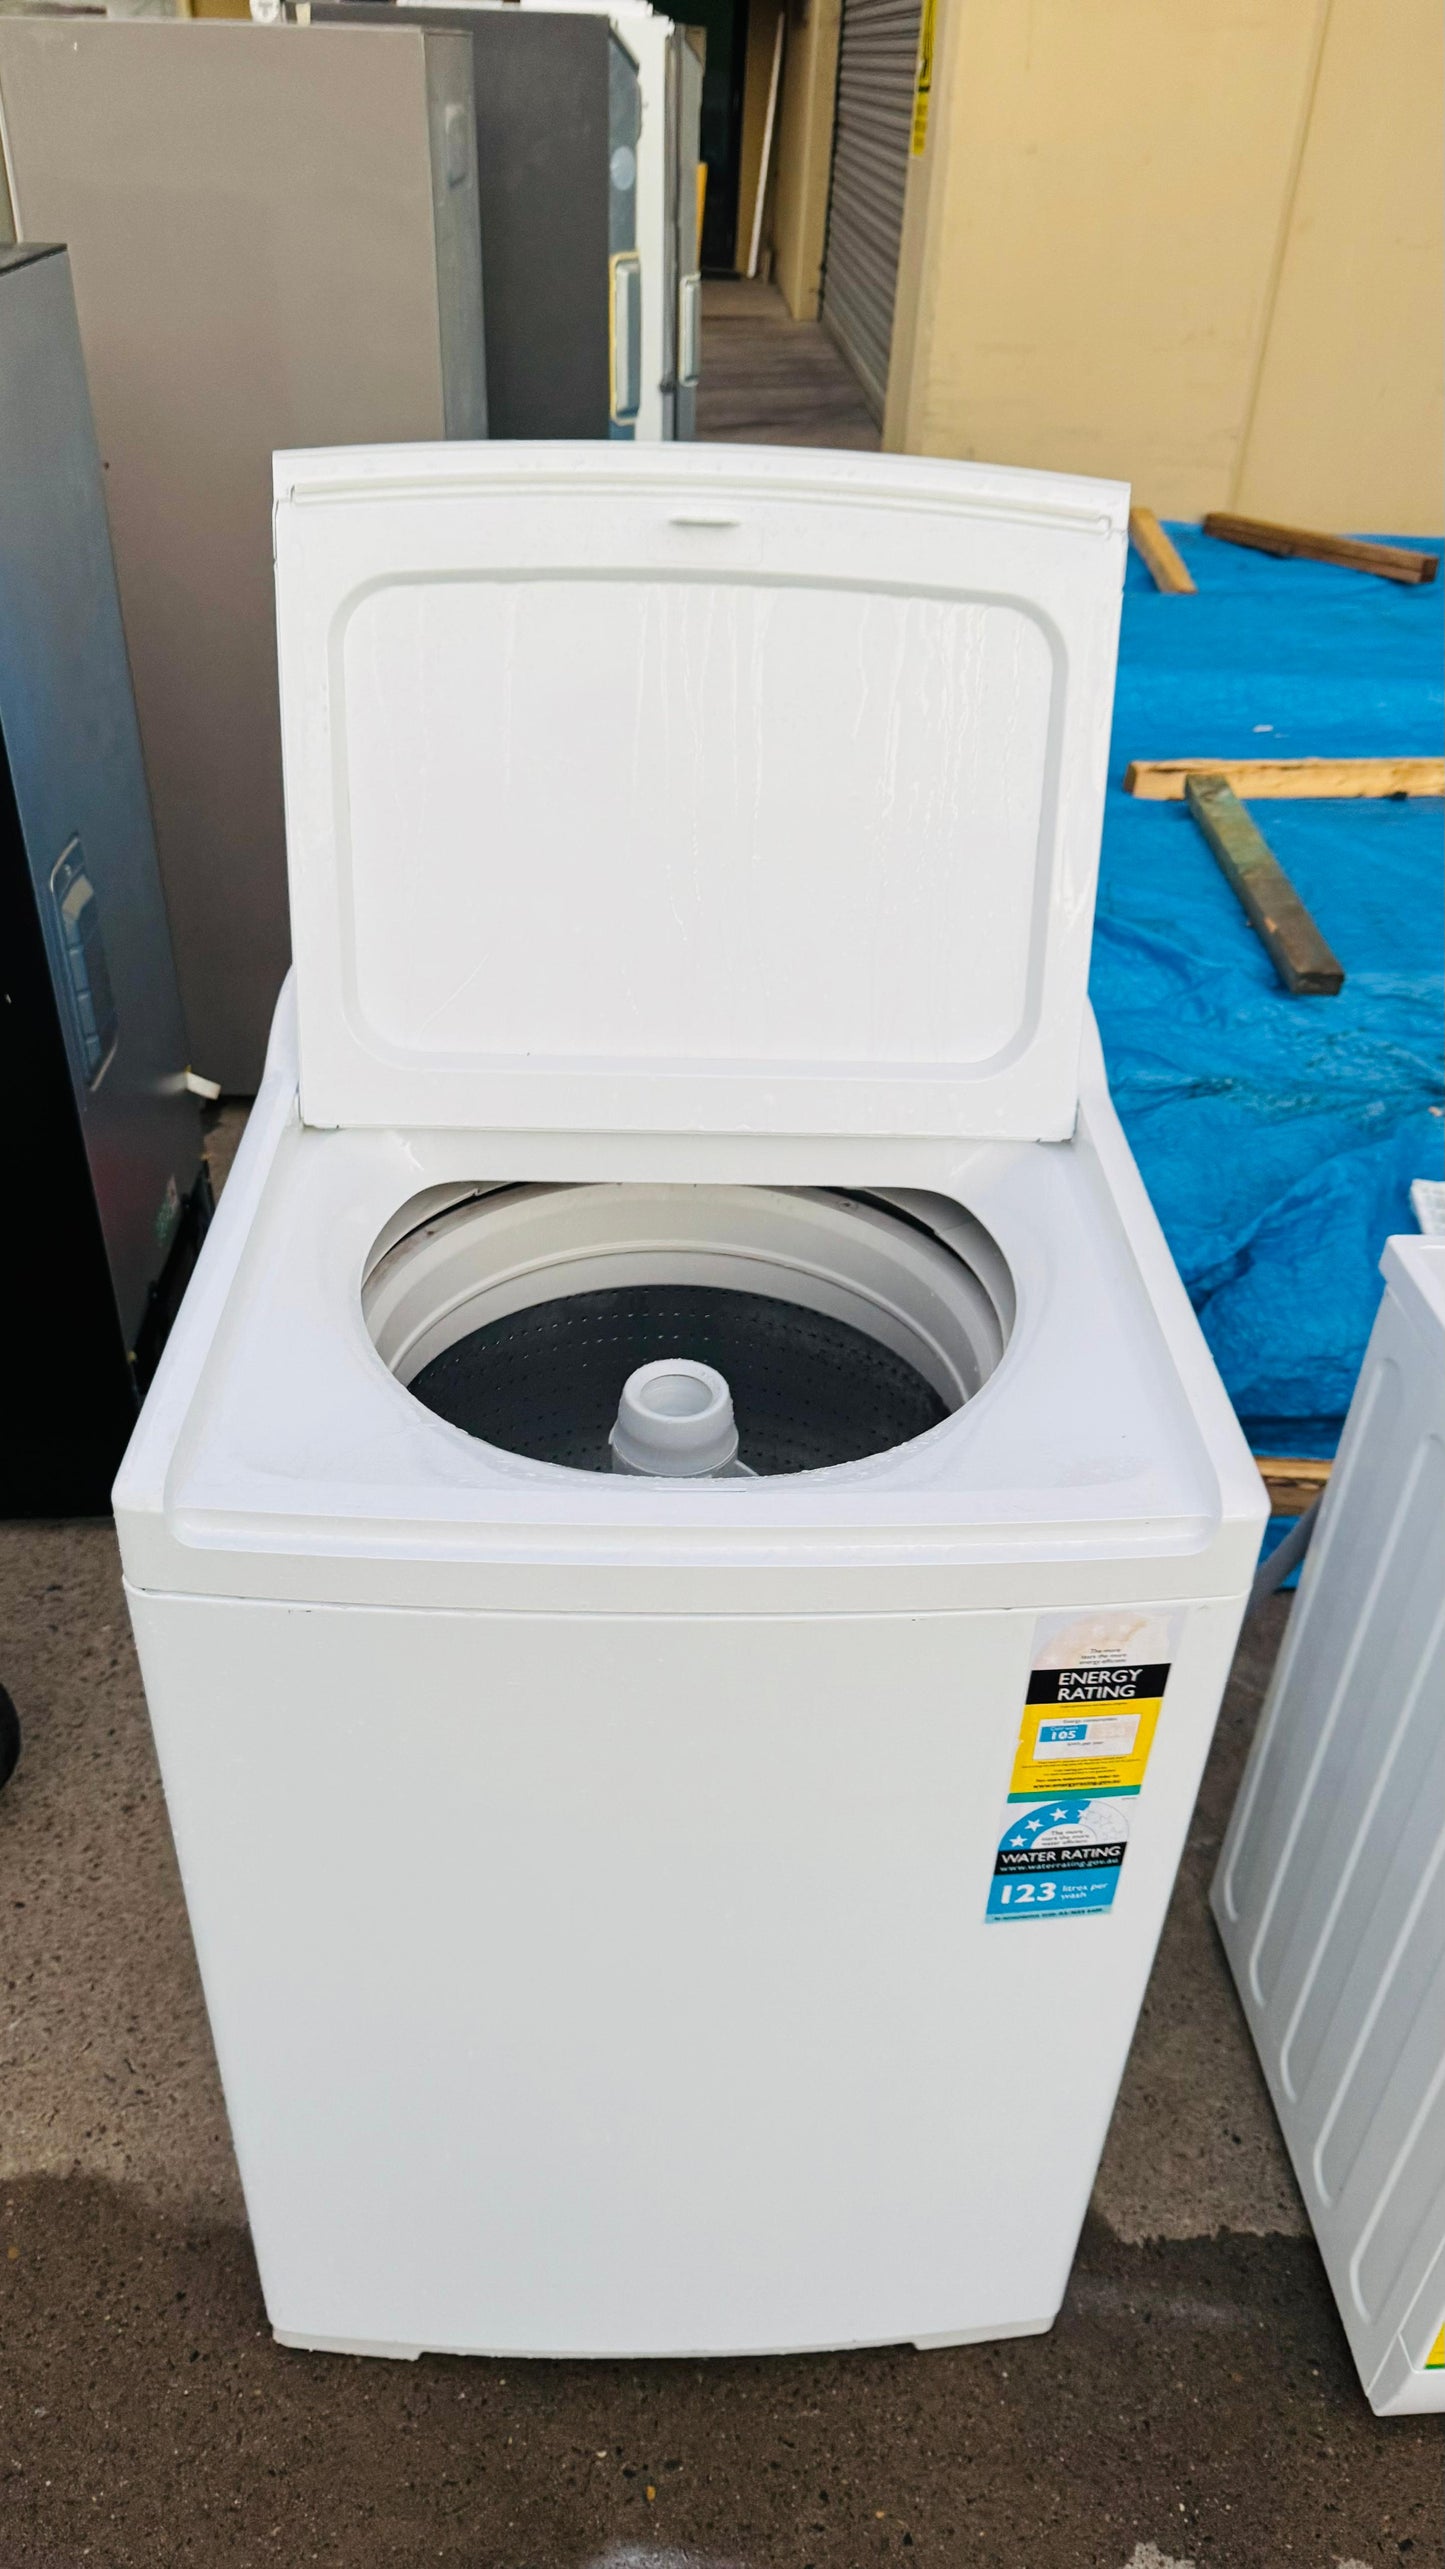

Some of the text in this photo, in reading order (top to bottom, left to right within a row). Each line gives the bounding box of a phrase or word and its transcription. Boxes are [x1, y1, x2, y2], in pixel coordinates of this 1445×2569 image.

[1058, 1669, 1143, 1686] ENERGY
[1057, 1684, 1137, 1701] RATING
[1051, 1730, 1077, 1741] 105
[1001, 1846, 1122, 1864] WATER RATING
[999, 1858, 1119, 1872] www.waterrating.gov.au
[1001, 1882, 1057, 1905] 123
[1090, 1883, 1109, 1892] per
